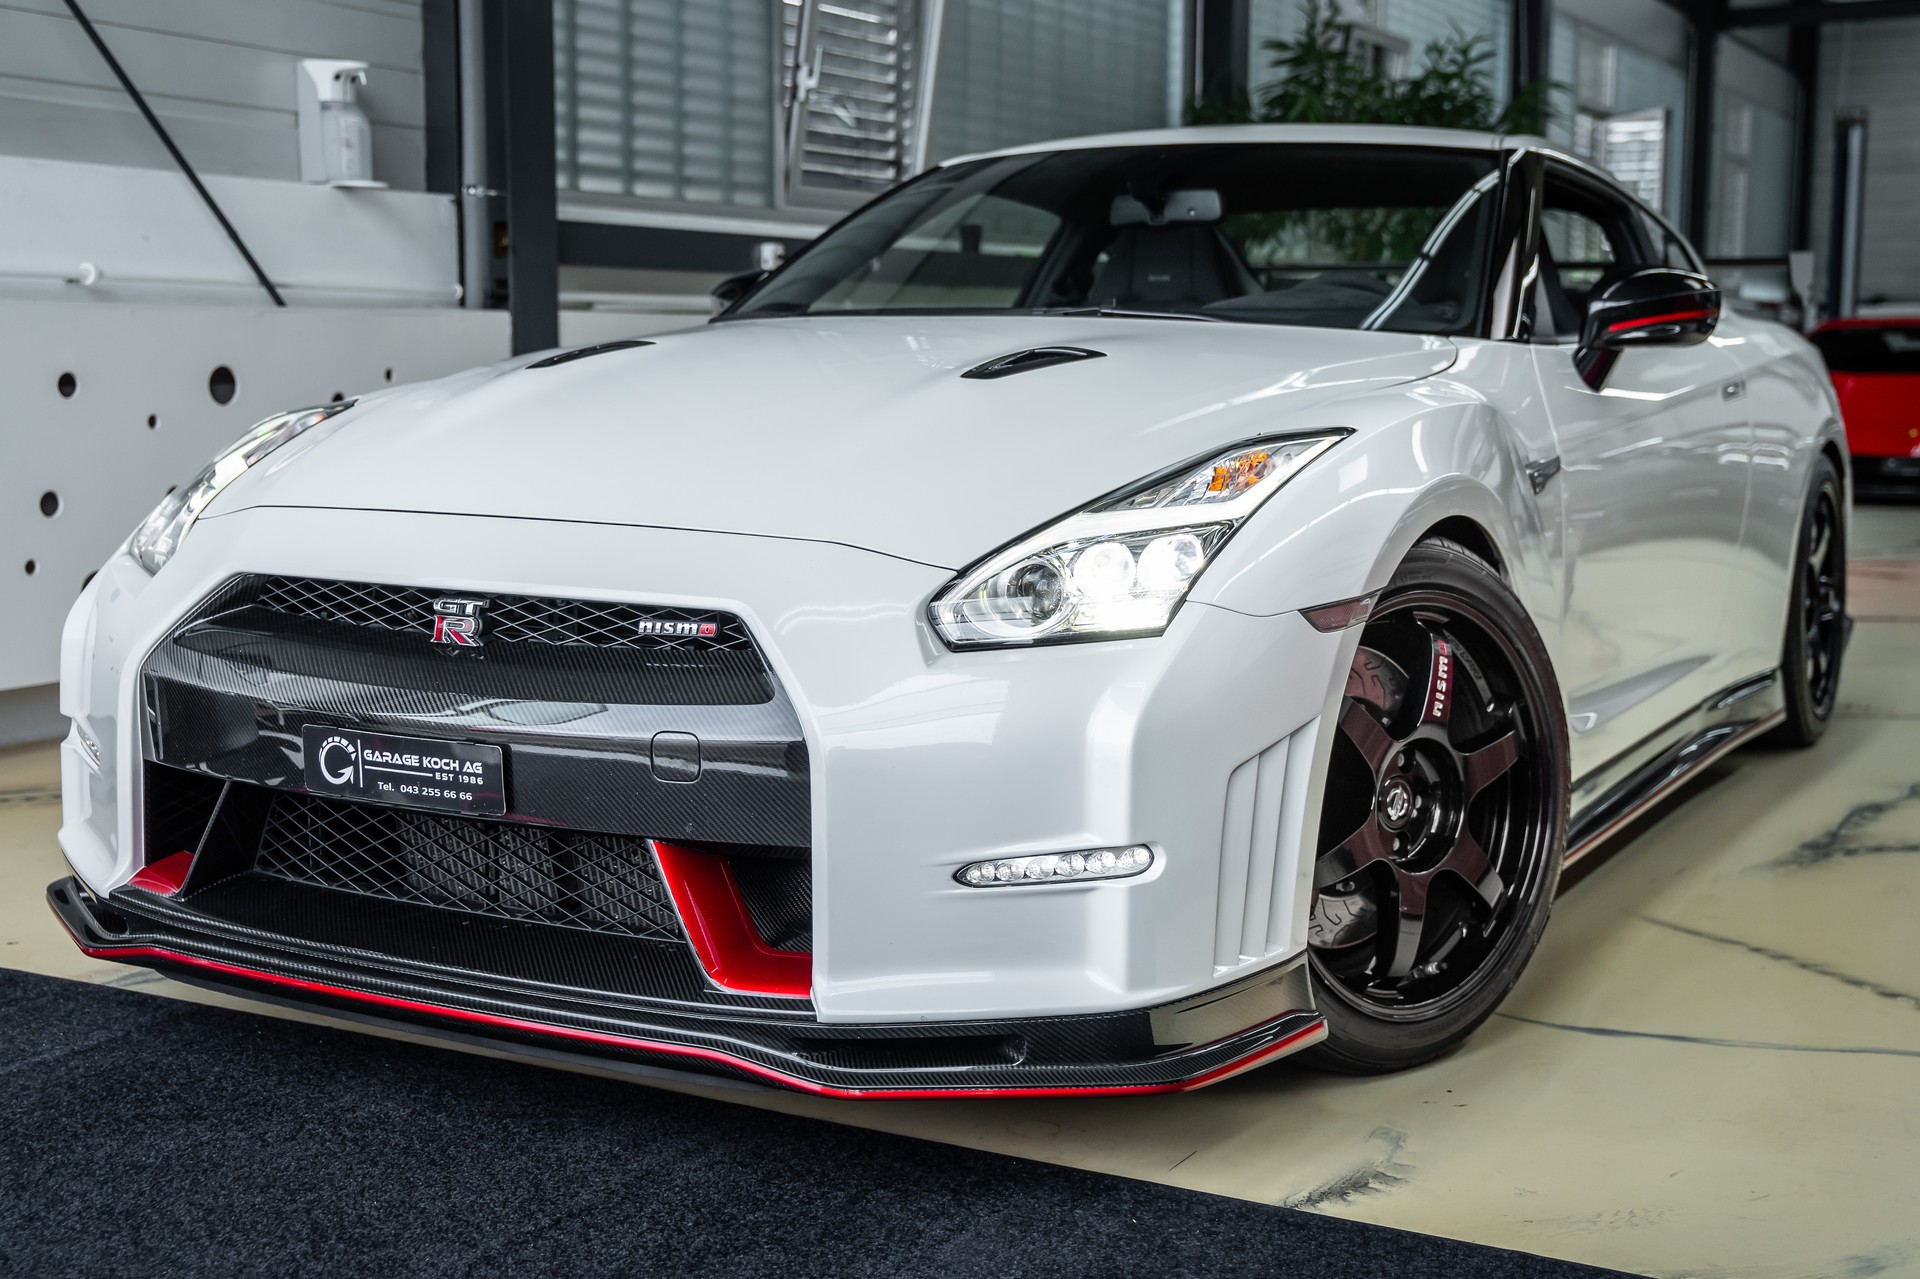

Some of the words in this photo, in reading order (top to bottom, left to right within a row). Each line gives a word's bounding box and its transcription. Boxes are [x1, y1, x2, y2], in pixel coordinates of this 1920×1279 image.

[433, 599, 489, 615] GT
[430, 615, 483, 646] R
[363, 749, 420, 767] GARAGE
[422, 756, 460, 771] KOCH
[462, 761, 483, 774] AG
[435, 772, 454, 781] EST
[458, 775, 484, 785] 1986
[377, 781, 395, 792] Tel.
[400, 784, 419, 794] 043
[421, 787, 441, 797] 255
[443, 790, 457, 799] 66
[459, 792, 473, 801] 66
